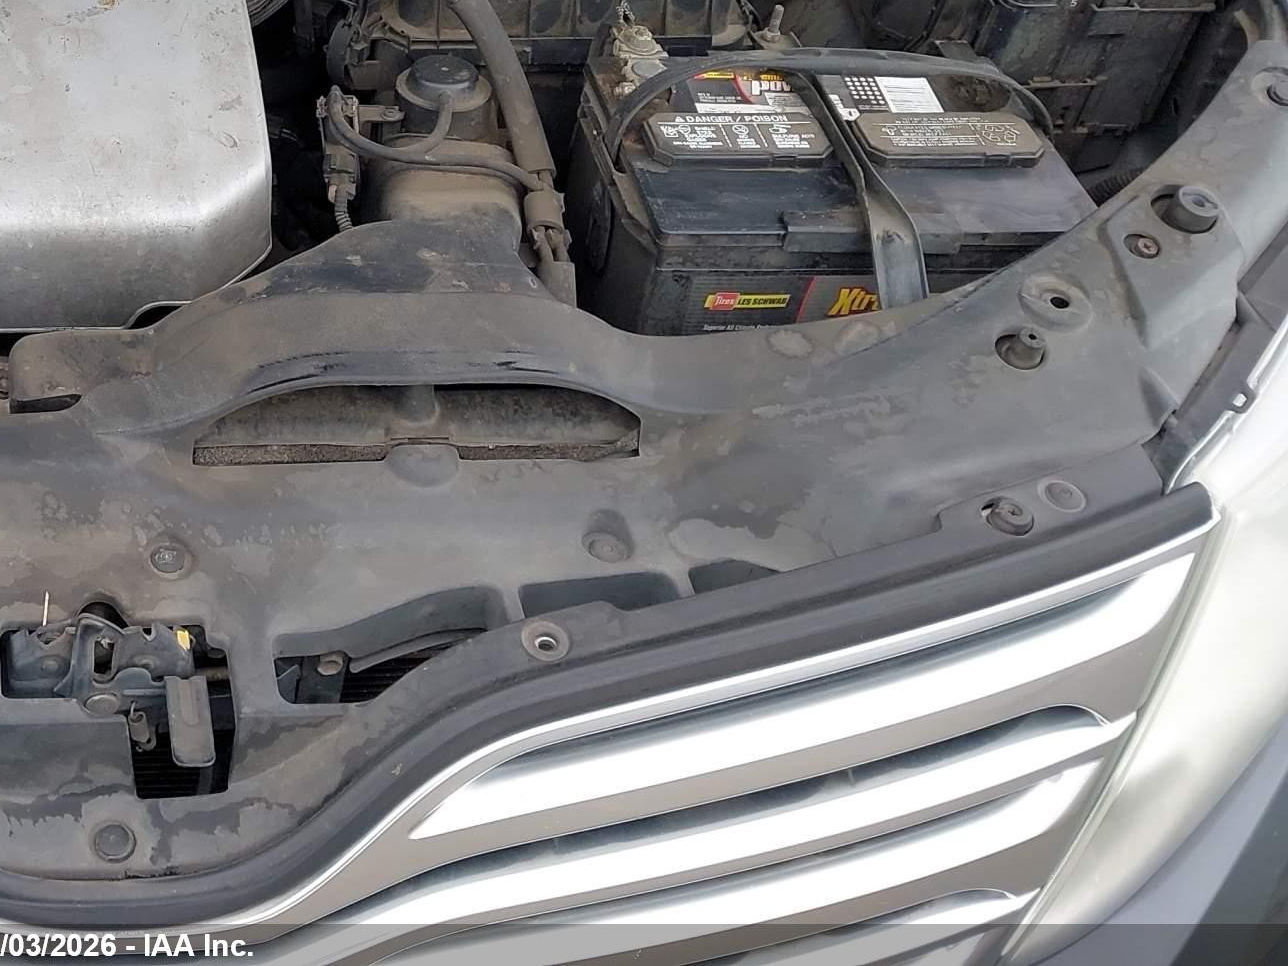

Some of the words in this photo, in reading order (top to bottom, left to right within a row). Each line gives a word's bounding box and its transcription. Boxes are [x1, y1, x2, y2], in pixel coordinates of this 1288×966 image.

[686, 115, 734, 123] DANGER
[715, 295, 735, 307] Tires
[737, 298, 752, 306] LES
[752, 297, 788, 306] SCHWAB
